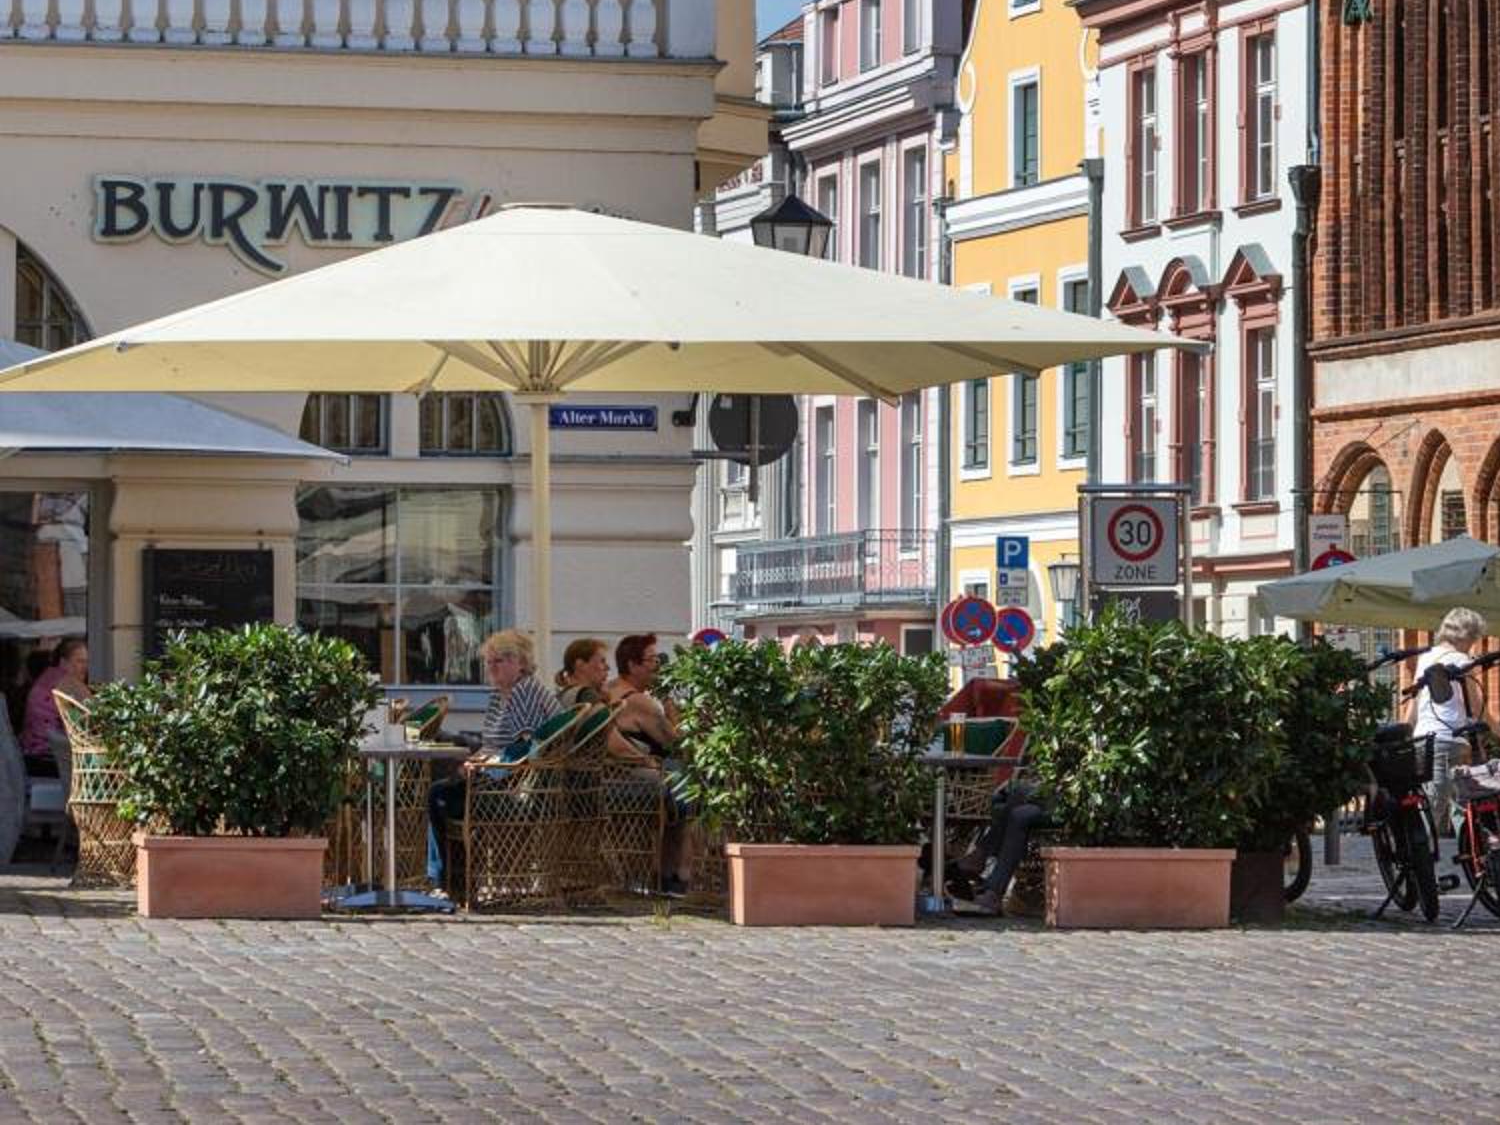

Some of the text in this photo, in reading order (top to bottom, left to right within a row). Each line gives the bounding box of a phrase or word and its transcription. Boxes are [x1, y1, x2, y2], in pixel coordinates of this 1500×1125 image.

[101, 180, 462, 272] BURWITZ
[560, 410, 643, 425] Alter Markt
[1119, 520, 1151, 545] 30
[1003, 540, 1022, 565] P
[1115, 565, 1157, 580] ZONE
